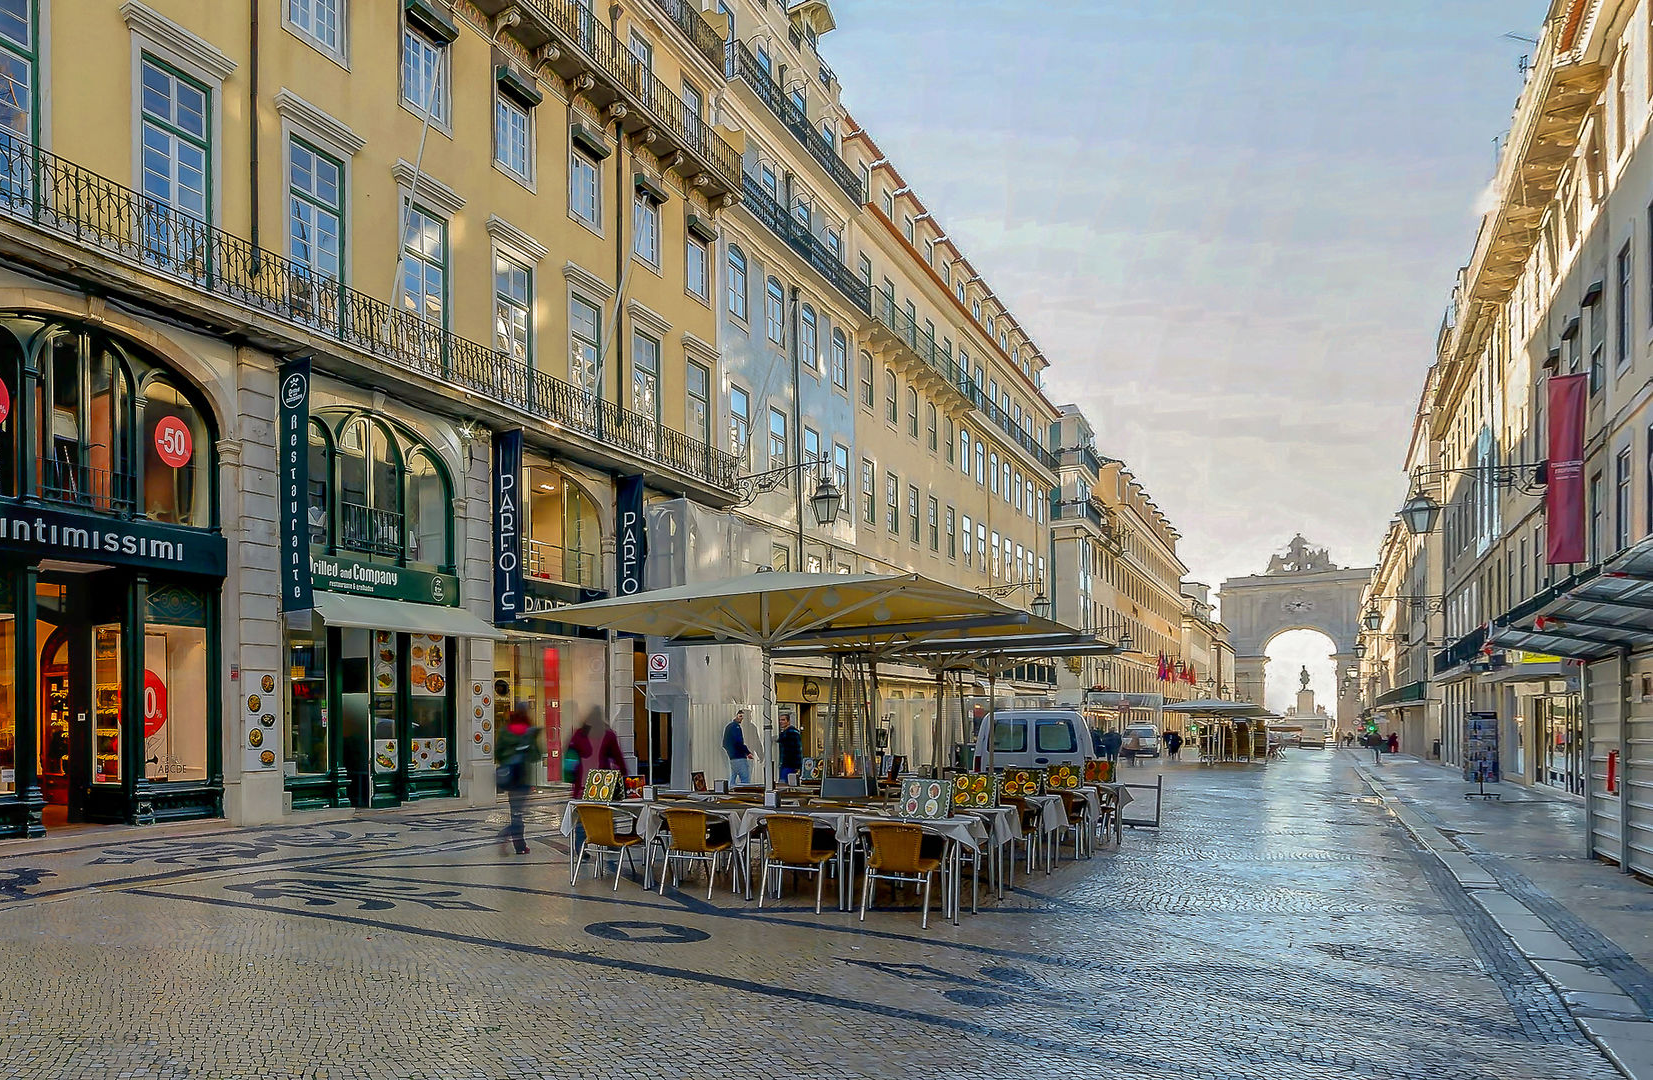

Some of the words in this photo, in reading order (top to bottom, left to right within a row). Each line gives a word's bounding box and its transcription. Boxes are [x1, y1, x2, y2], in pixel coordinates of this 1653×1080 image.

[290, 414, 301, 598] Restaurante
[0, 517, 184, 562] intimissimi
[499, 474, 517, 611] PARFOIS
[621, 511, 639, 595] PARFO
[339, 568, 353, 580] and
[353, 563, 398, 586] Company
[158, 764, 187, 774] ABCDE
